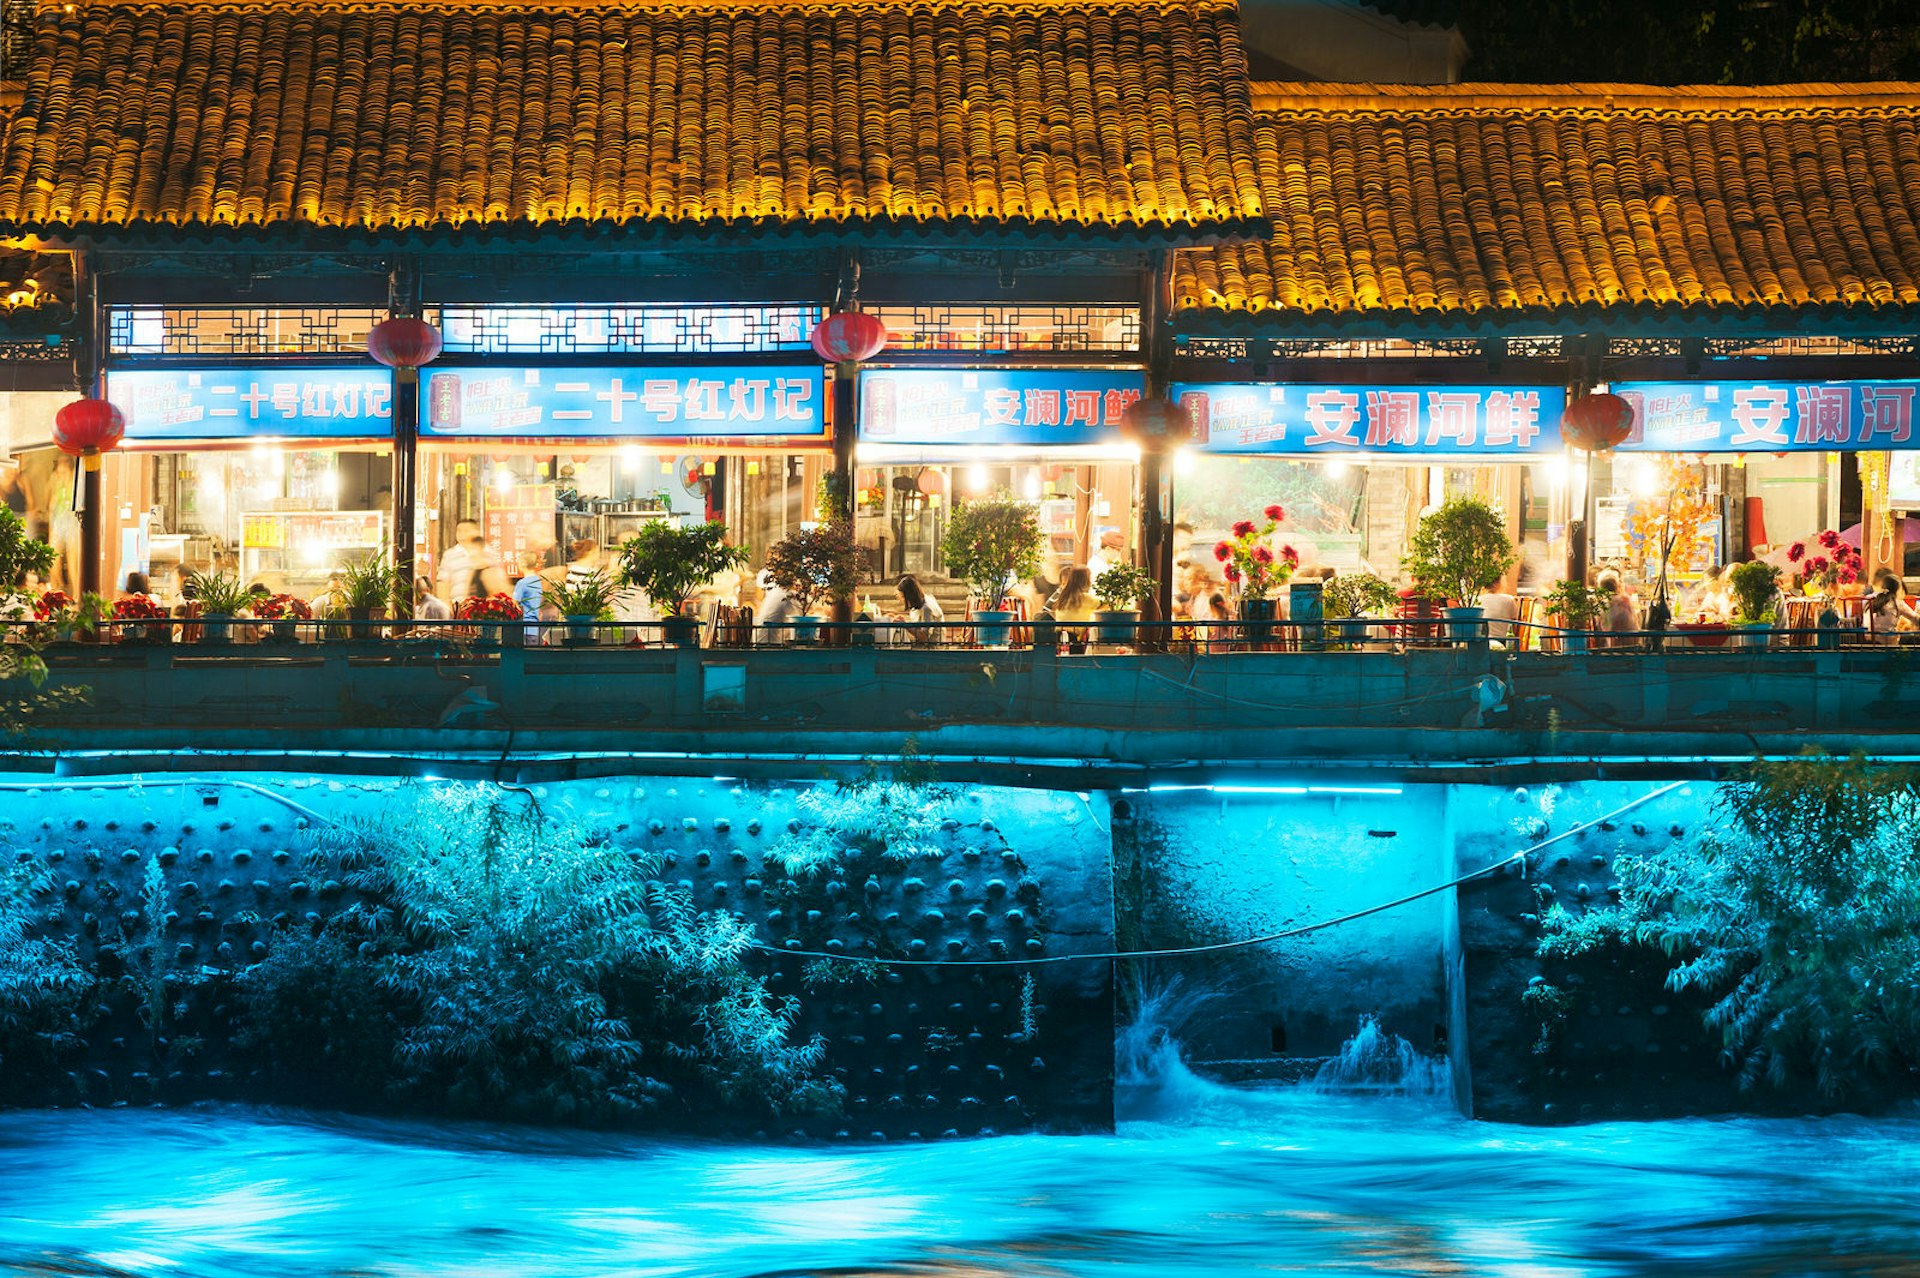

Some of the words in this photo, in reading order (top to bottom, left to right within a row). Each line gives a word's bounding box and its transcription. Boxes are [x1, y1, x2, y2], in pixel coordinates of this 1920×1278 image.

[209, 382, 392, 419] 二十号红灯记
[551, 378, 814, 423] 二十号红灯记
[983, 388, 1141, 427] 安澜河鲜
[1304, 390, 1541, 447] 安澜河鲜
[1648, 394, 1691, 415] 怕上火
[1731, 386, 1916, 445] 安澜河
[1237, 423, 1287, 445] 王老吉
